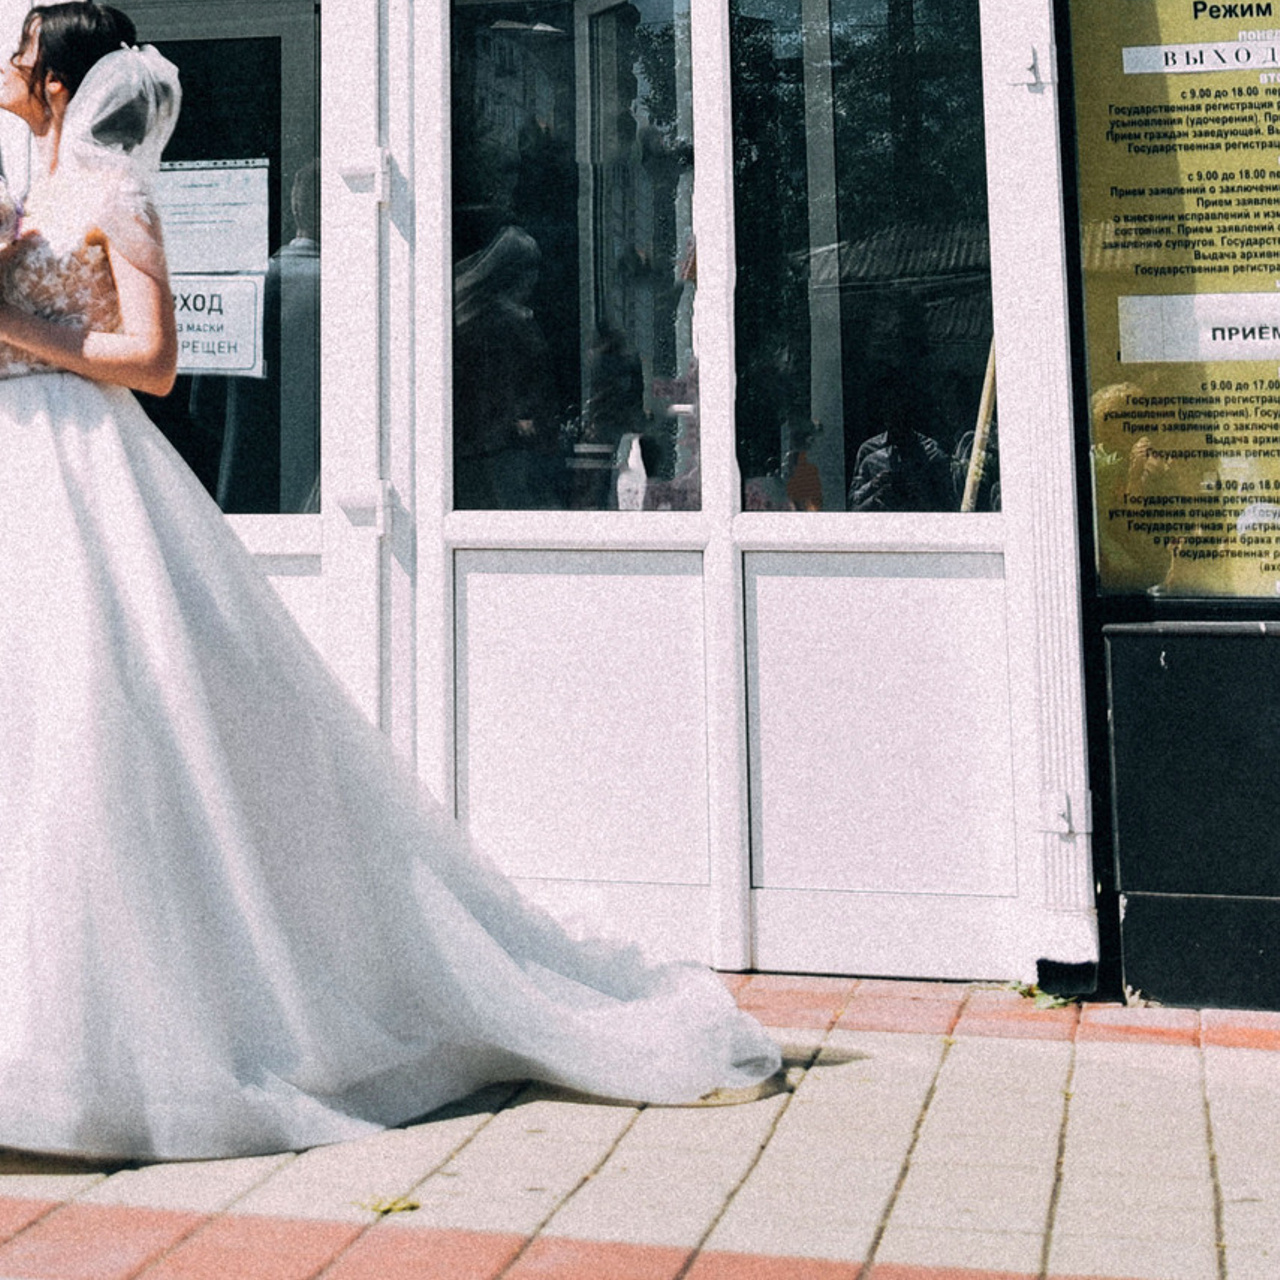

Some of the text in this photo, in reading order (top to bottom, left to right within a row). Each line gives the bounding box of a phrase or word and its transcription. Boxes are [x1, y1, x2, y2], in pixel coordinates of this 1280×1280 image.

[1193, 0, 1272, 19] Режим
[1180, 91, 1187, 99] с
[1189, 88, 1212, 99] 9.00
[1214, 89, 1228, 99] до
[1231, 86, 1259, 98] 18.00
[1108, 102, 1202, 116] Государственная
[1205, 100, 1274, 114] регистрация
[1144, 129, 1189, 141] граждан
[1127, 141, 1221, 155] Государственная
[1188, 173, 1194, 181] с
[1196, 170, 1218, 181] 9.00
[1221, 172, 1235, 182] до
[1239, 168, 1266, 180] 18.00
[1110, 186, 1145, 199] Прием
[1209, 186, 1216, 194] о
[1196, 197, 1232, 210] Прием
[1177, 224, 1212, 237] Прием
[1216, 221, 1275, 234] заявлений
[1194, 250, 1237, 261] Выдача
[1135, 264, 1229, 277] Государственная
[173, 293, 223, 315] ХОД
[186, 323, 224, 332] МАСКИ
[182, 341, 238, 355] РЕЩЕН
[1201, 382, 1208, 391] с
[1210, 380, 1232, 391] 9.00
[1235, 382, 1249, 392] до
[1126, 394, 1220, 408] Государственная
[1123, 421, 1158, 434] Прием
[1223, 422, 1230, 431] о
[1206, 433, 1249, 446] Выдача
[1146, 447, 1241, 460] Государственная
[1240, 481, 1255, 492] до
[1259, 480, 1280, 490] 18.0
[1123, 493, 1219, 507] Государственная
[1173, 546, 1270, 560] Государственная
